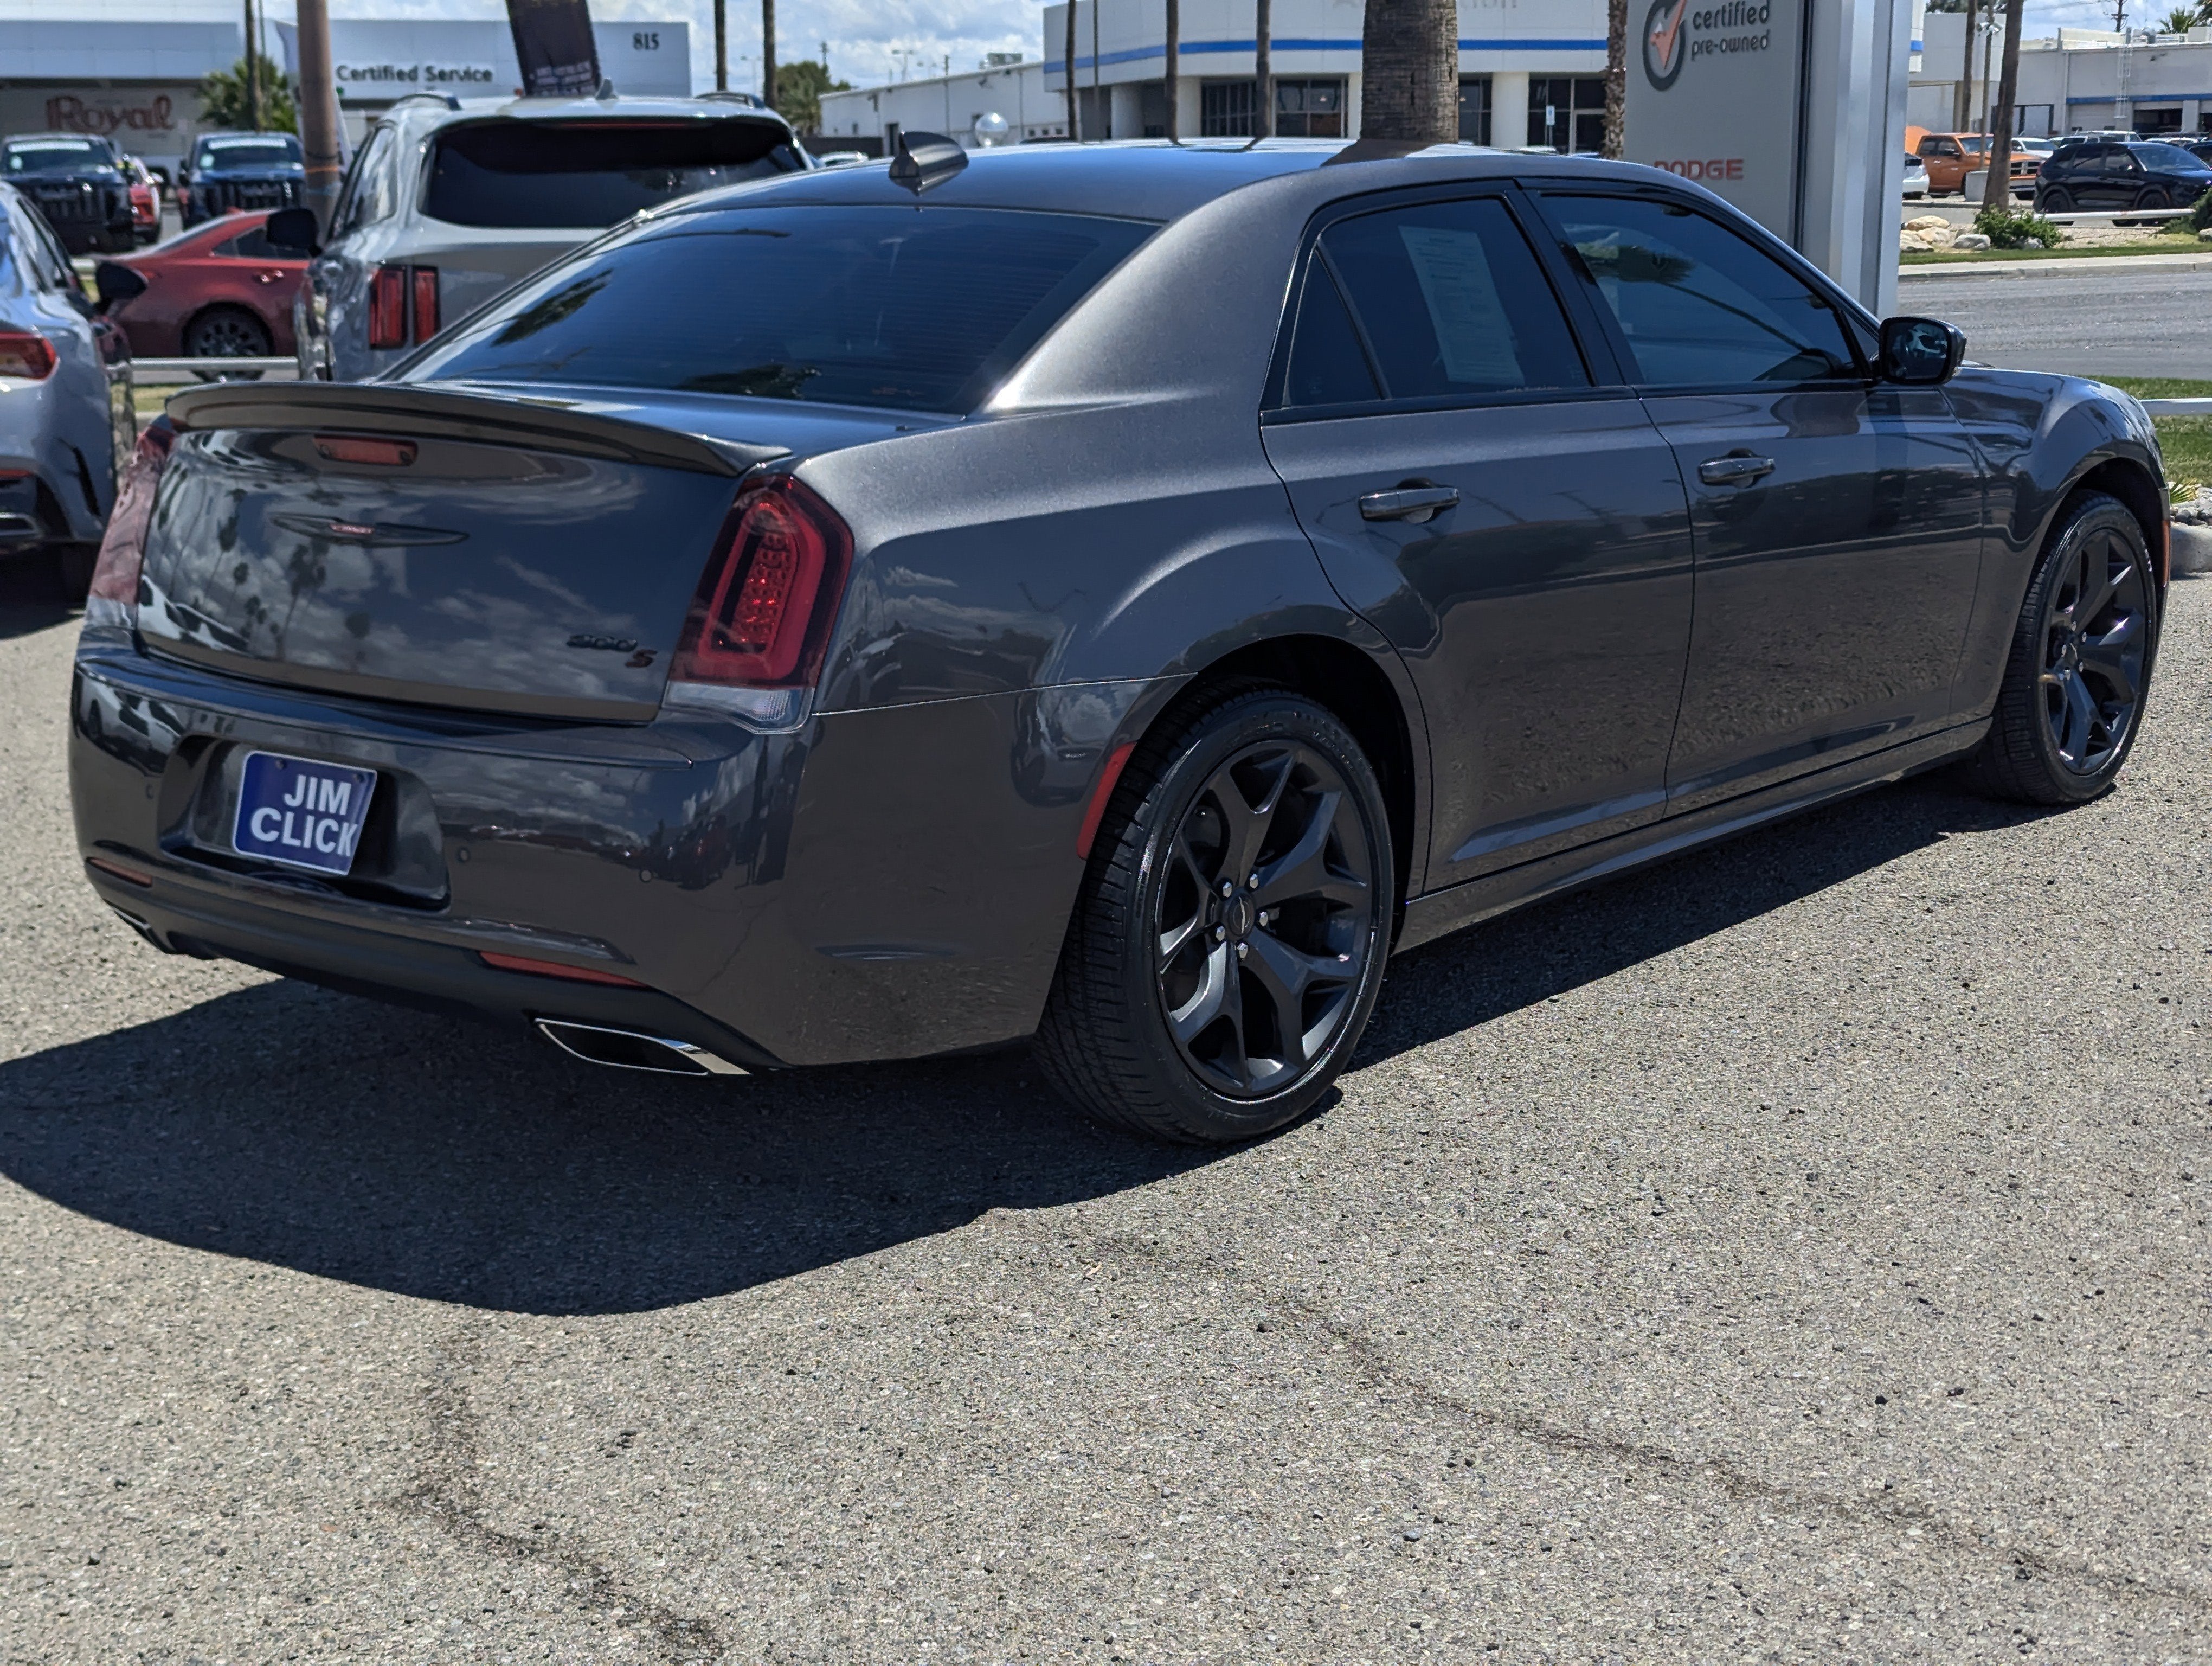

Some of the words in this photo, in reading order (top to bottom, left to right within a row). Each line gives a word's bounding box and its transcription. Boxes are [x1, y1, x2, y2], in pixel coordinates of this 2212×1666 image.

[1693, 0, 1770, 30] certified
[633, 32, 659, 50] 815
[1691, 29, 1770, 61] pre-owned
[336, 65, 418, 81] Certified
[425, 65, 493, 81] Service
[46, 95, 174, 135] Royal
[284, 774, 352, 816] JIM
[250, 806, 358, 856] CLICK
